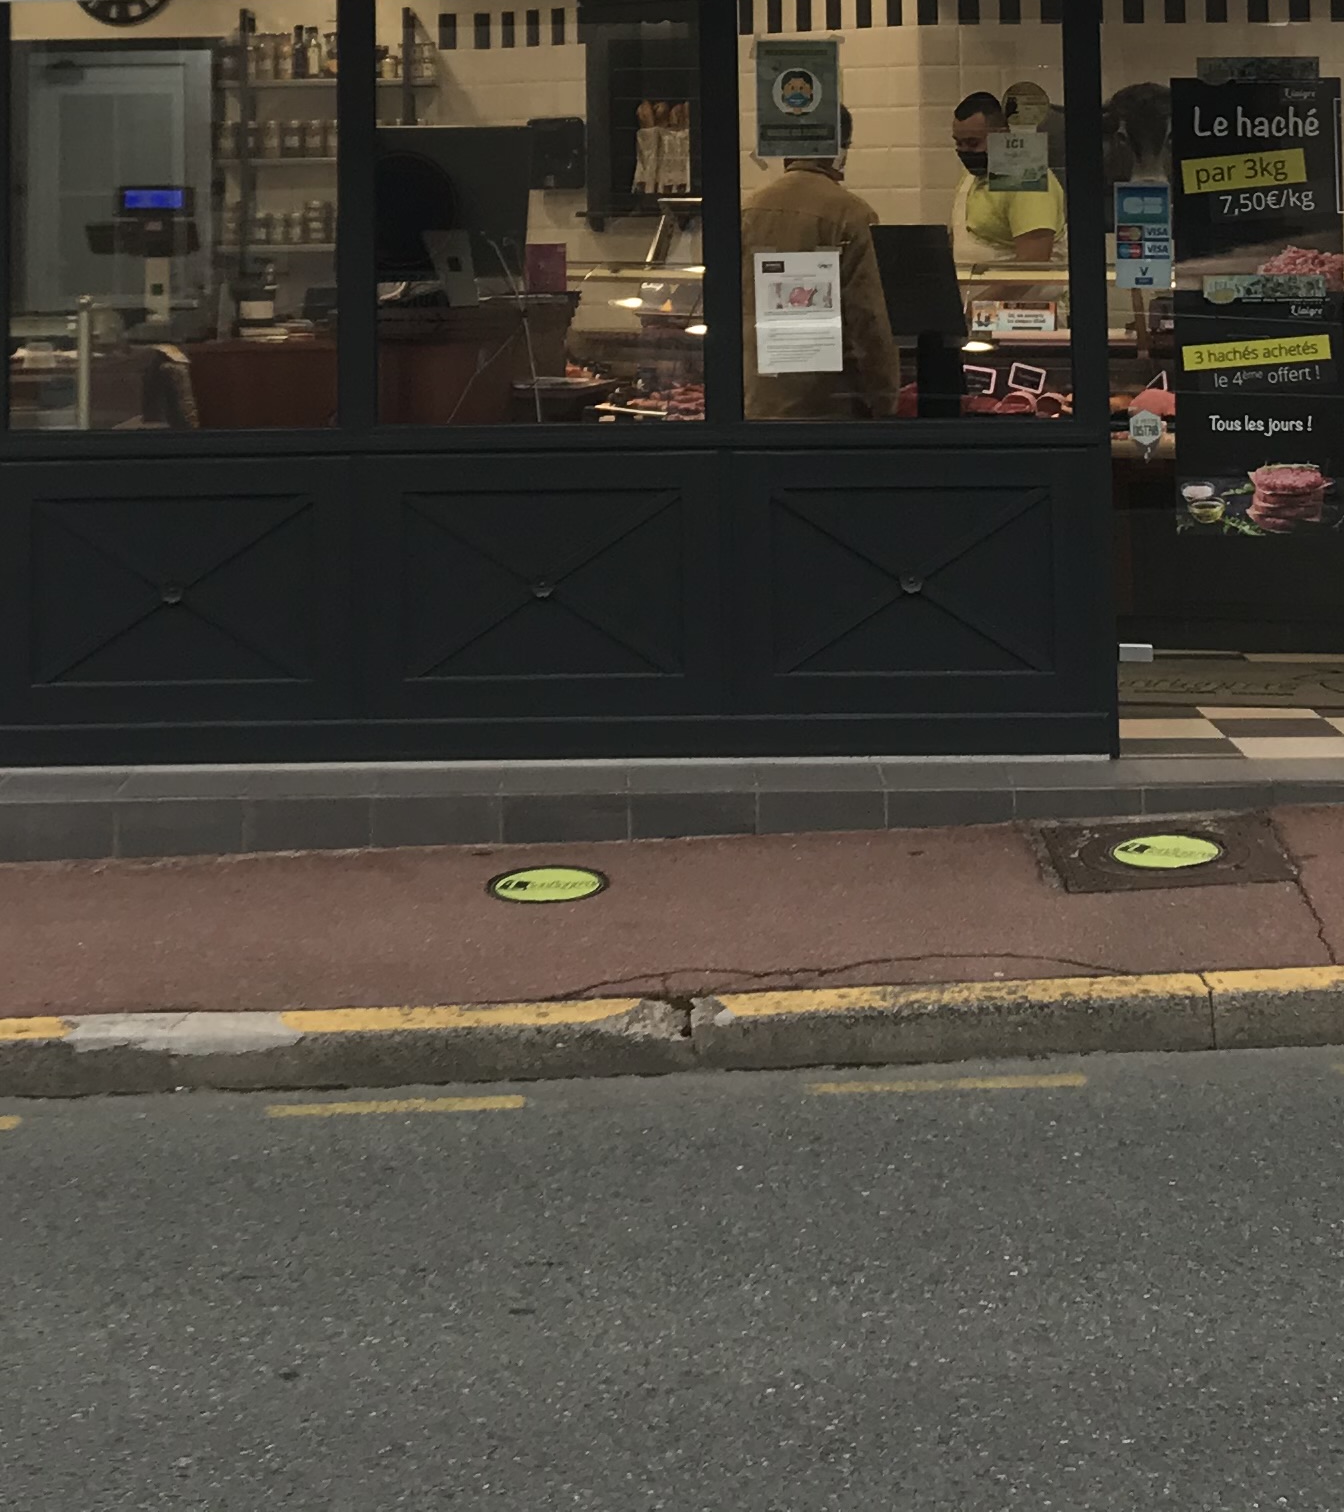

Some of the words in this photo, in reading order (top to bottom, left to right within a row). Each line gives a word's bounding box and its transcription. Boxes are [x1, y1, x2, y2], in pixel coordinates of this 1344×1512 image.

[1193, 105, 1229, 137] Le
[1236, 105, 1320, 138] haché
[1006, 138, 1025, 149] ICI
[1195, 163, 1237, 190] par
[1243, 156, 1288, 182] 3kg
[1218, 188, 1316, 217] 7,50€/kg
[1146, 228, 1168, 237] VISA
[1146, 244, 1169, 254] VISA
[1193, 350, 1204, 365] 3
[1207, 345, 1259, 363] hachés
[1262, 341, 1319, 359] achetés
[1213, 373, 1229, 388] le
[1232, 369, 1263, 386] 4ème
[1267, 366, 1312, 384] offert
[1208, 414, 1242, 432] Tous
[1244, 414, 1265, 432] les
[1264, 416, 1304, 437] jours
[1306, 414, 1313, 432] !
